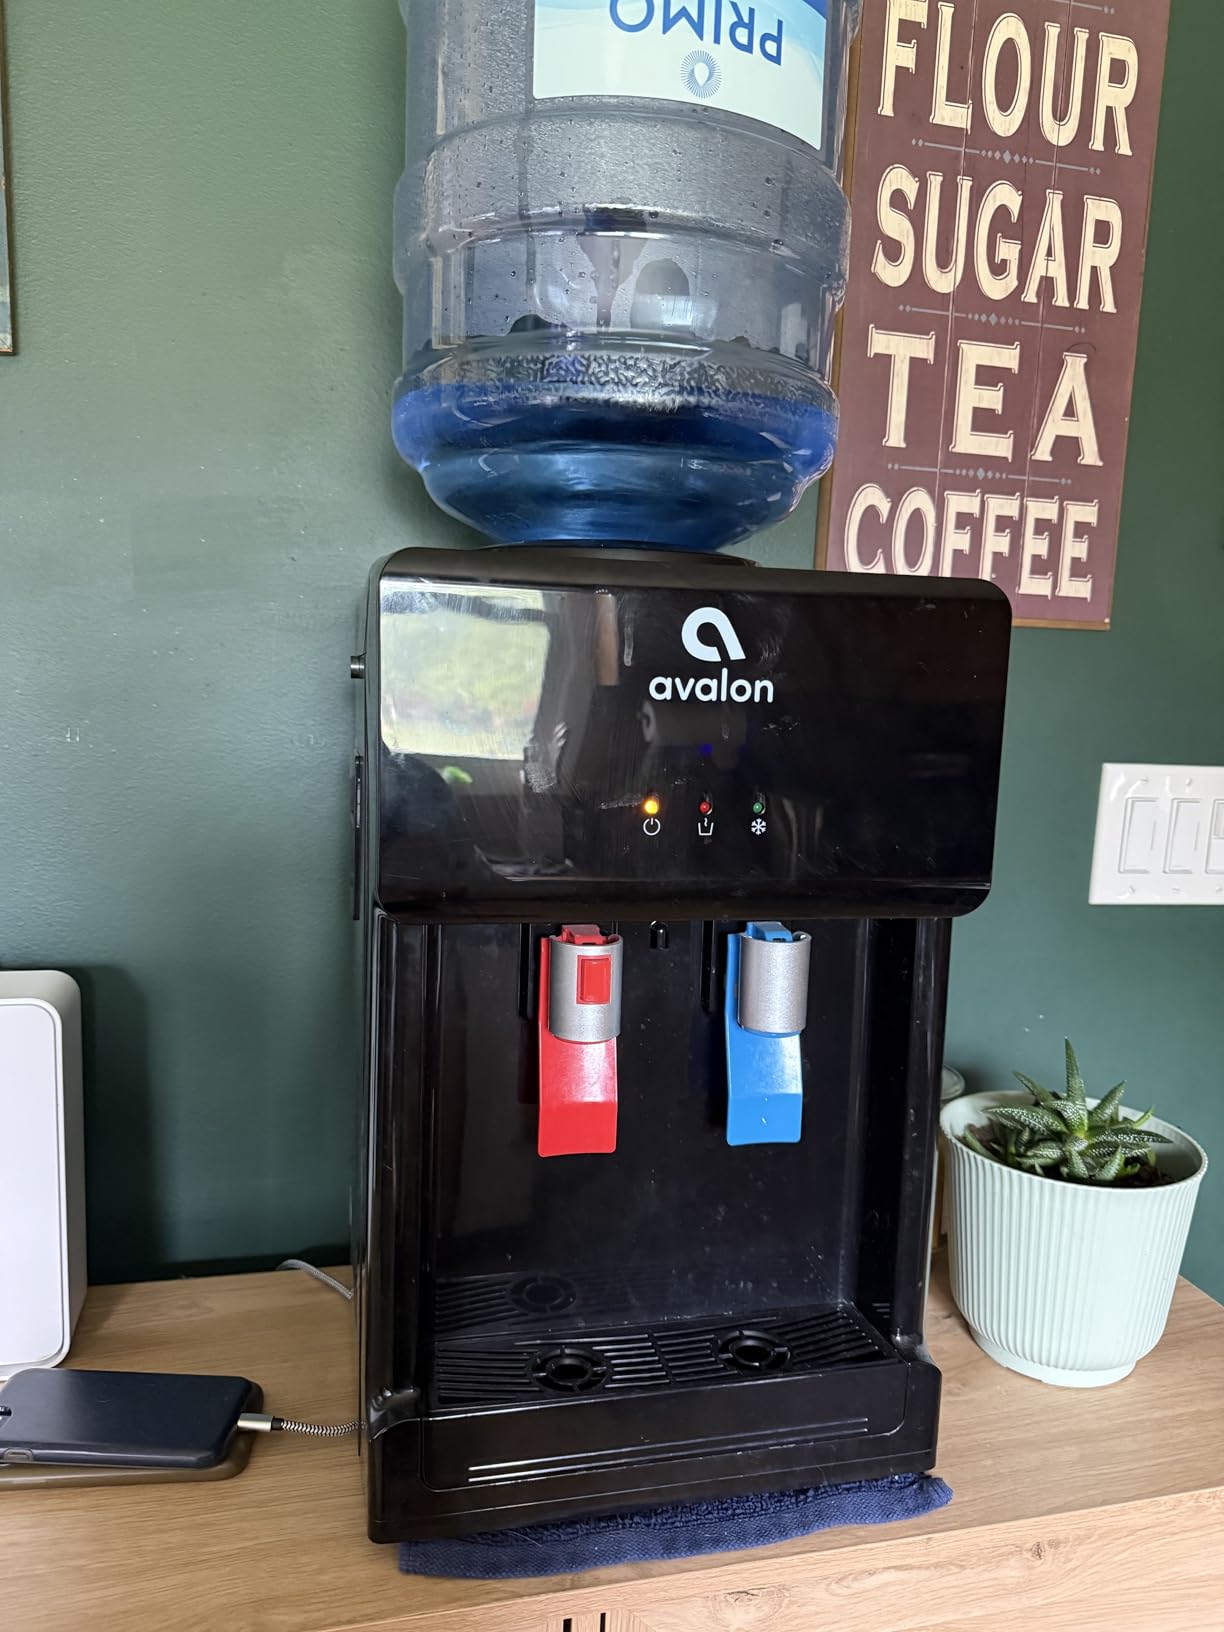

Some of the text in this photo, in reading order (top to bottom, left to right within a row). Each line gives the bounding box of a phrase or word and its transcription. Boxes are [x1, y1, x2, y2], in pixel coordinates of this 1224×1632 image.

[609, 0, 783, 66] PRIMO
[878, 0, 1139, 156] FLOUR
[871, 164, 1123, 313] SUGAR
[867, 324, 1104, 466] TEA
[844, 483, 1099, 602] COFFEE
[649, 667, 774, 703] avalon
